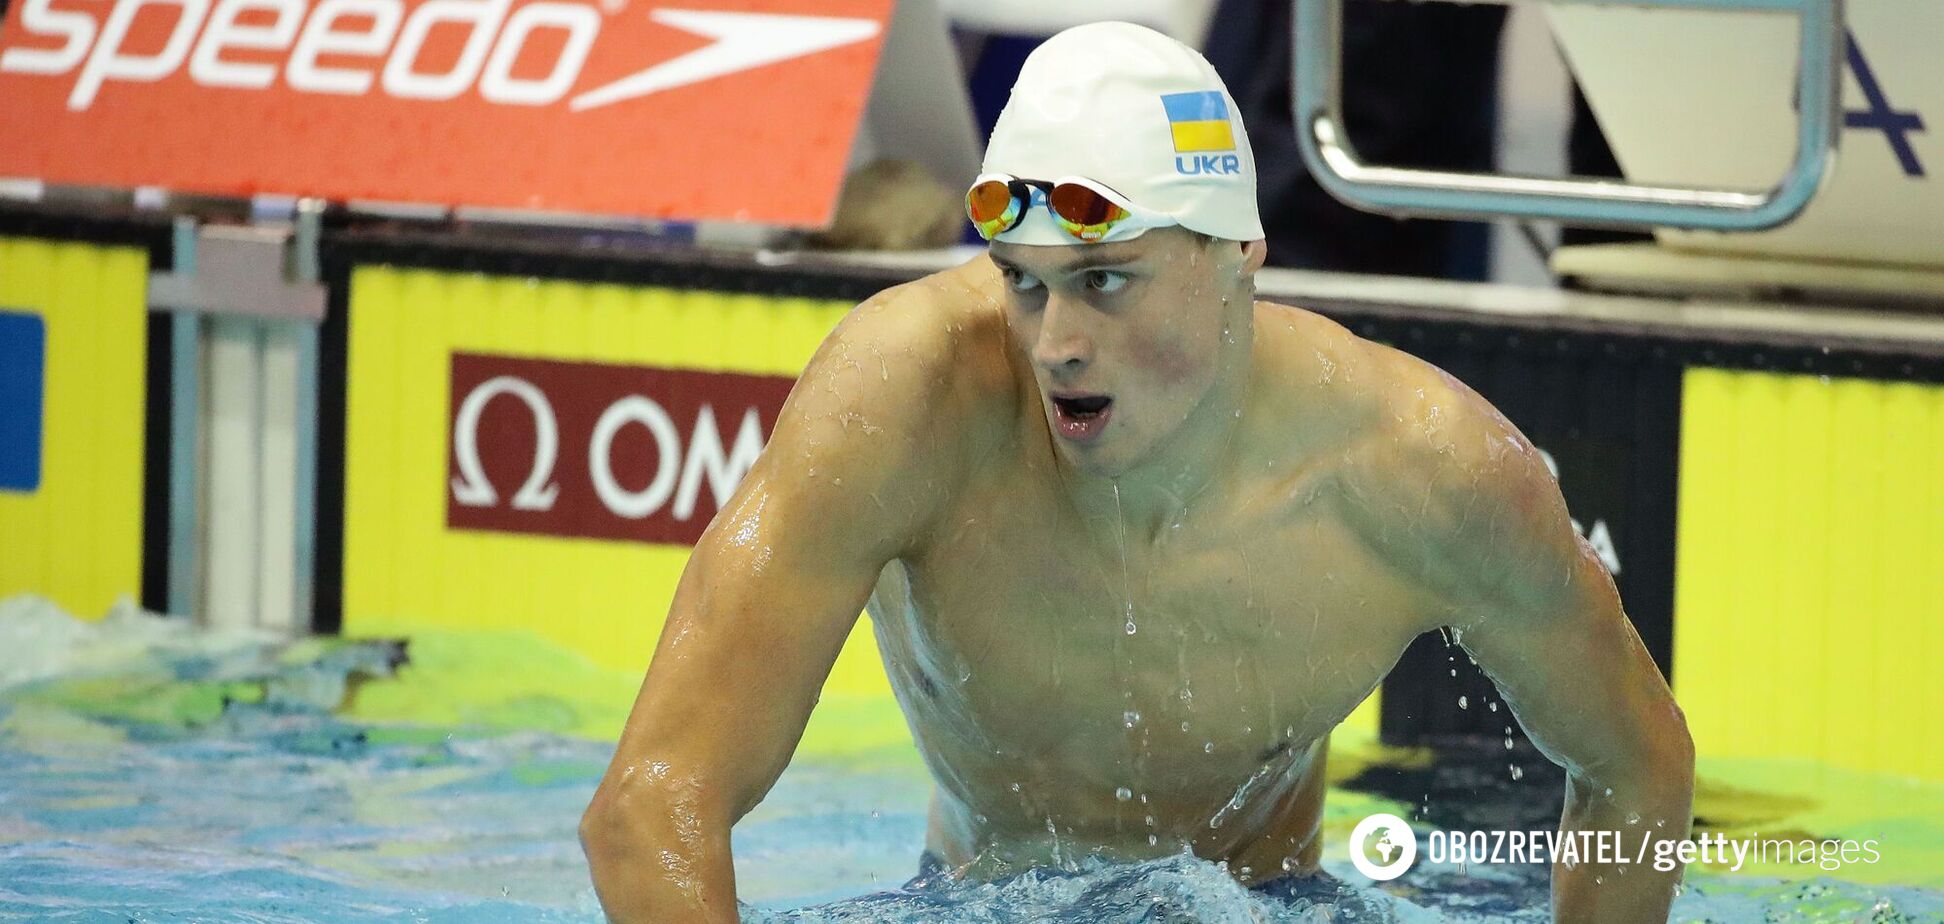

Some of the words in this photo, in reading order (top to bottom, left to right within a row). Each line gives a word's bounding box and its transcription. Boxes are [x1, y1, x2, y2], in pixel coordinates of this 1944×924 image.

[0, 0, 602, 111] speedo
[1175, 153, 1241, 176] UKR
[588, 394, 765, 522] OM
